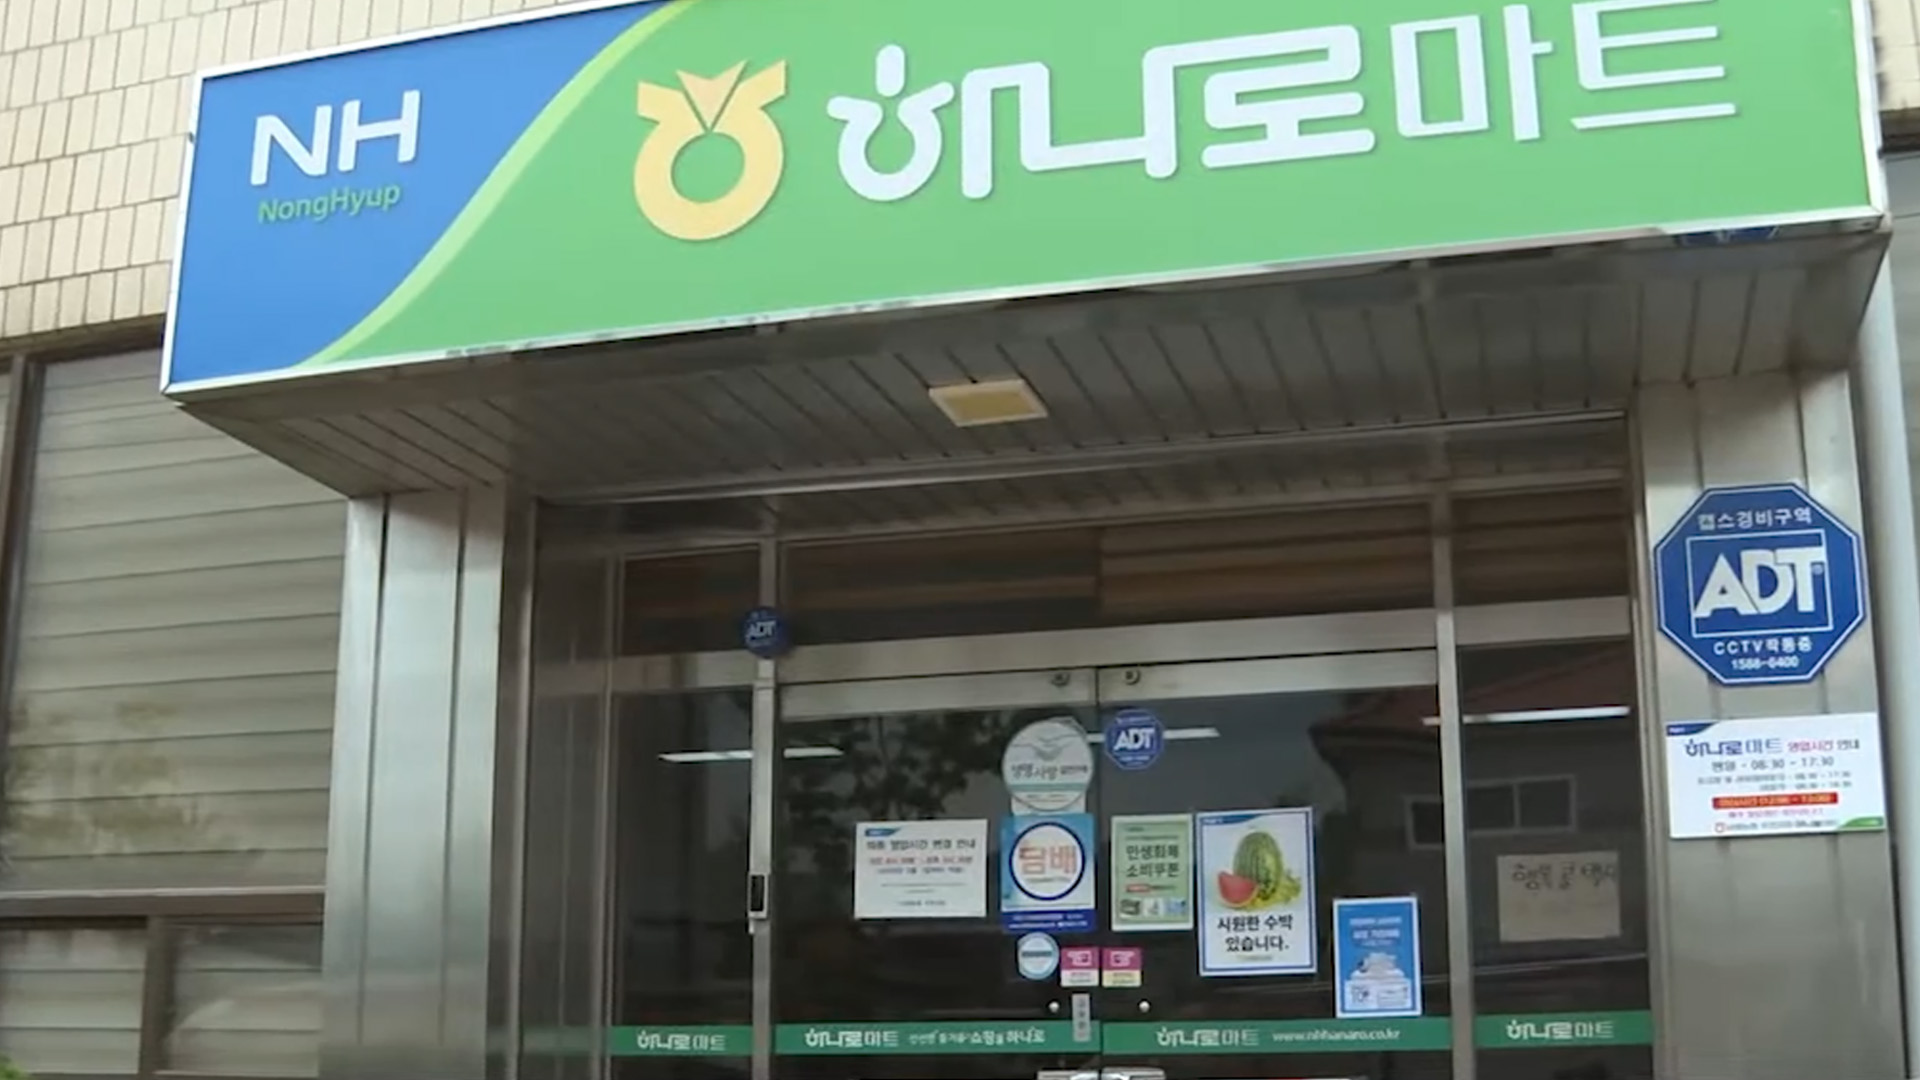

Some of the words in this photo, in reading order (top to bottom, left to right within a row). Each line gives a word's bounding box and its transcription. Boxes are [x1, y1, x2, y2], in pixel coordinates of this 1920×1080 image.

[827, 0, 1736, 201] 하나로마트
[250, 89, 421, 186] NH
[257, 182, 401, 225] NongHyup
[1698, 507, 1812, 530] 캡스경비구역
[1694, 546, 1825, 618] ADT
[1114, 727, 1156, 751] ADT
[1685, 738, 1784, 757] 하나로마트
[1018, 843, 1077, 876] 담배
[1217, 915, 1260, 932] 시원한
[1264, 914, 1294, 931] 수박
[1225, 935, 1290, 952] 있습니다.
[637, 1030, 725, 1050] 하나로마트
[804, 1027, 899, 1048] 하나로마트
[1157, 1027, 1259, 1047] 하나로마트
[1506, 1019, 1615, 1040] 하나로마트
